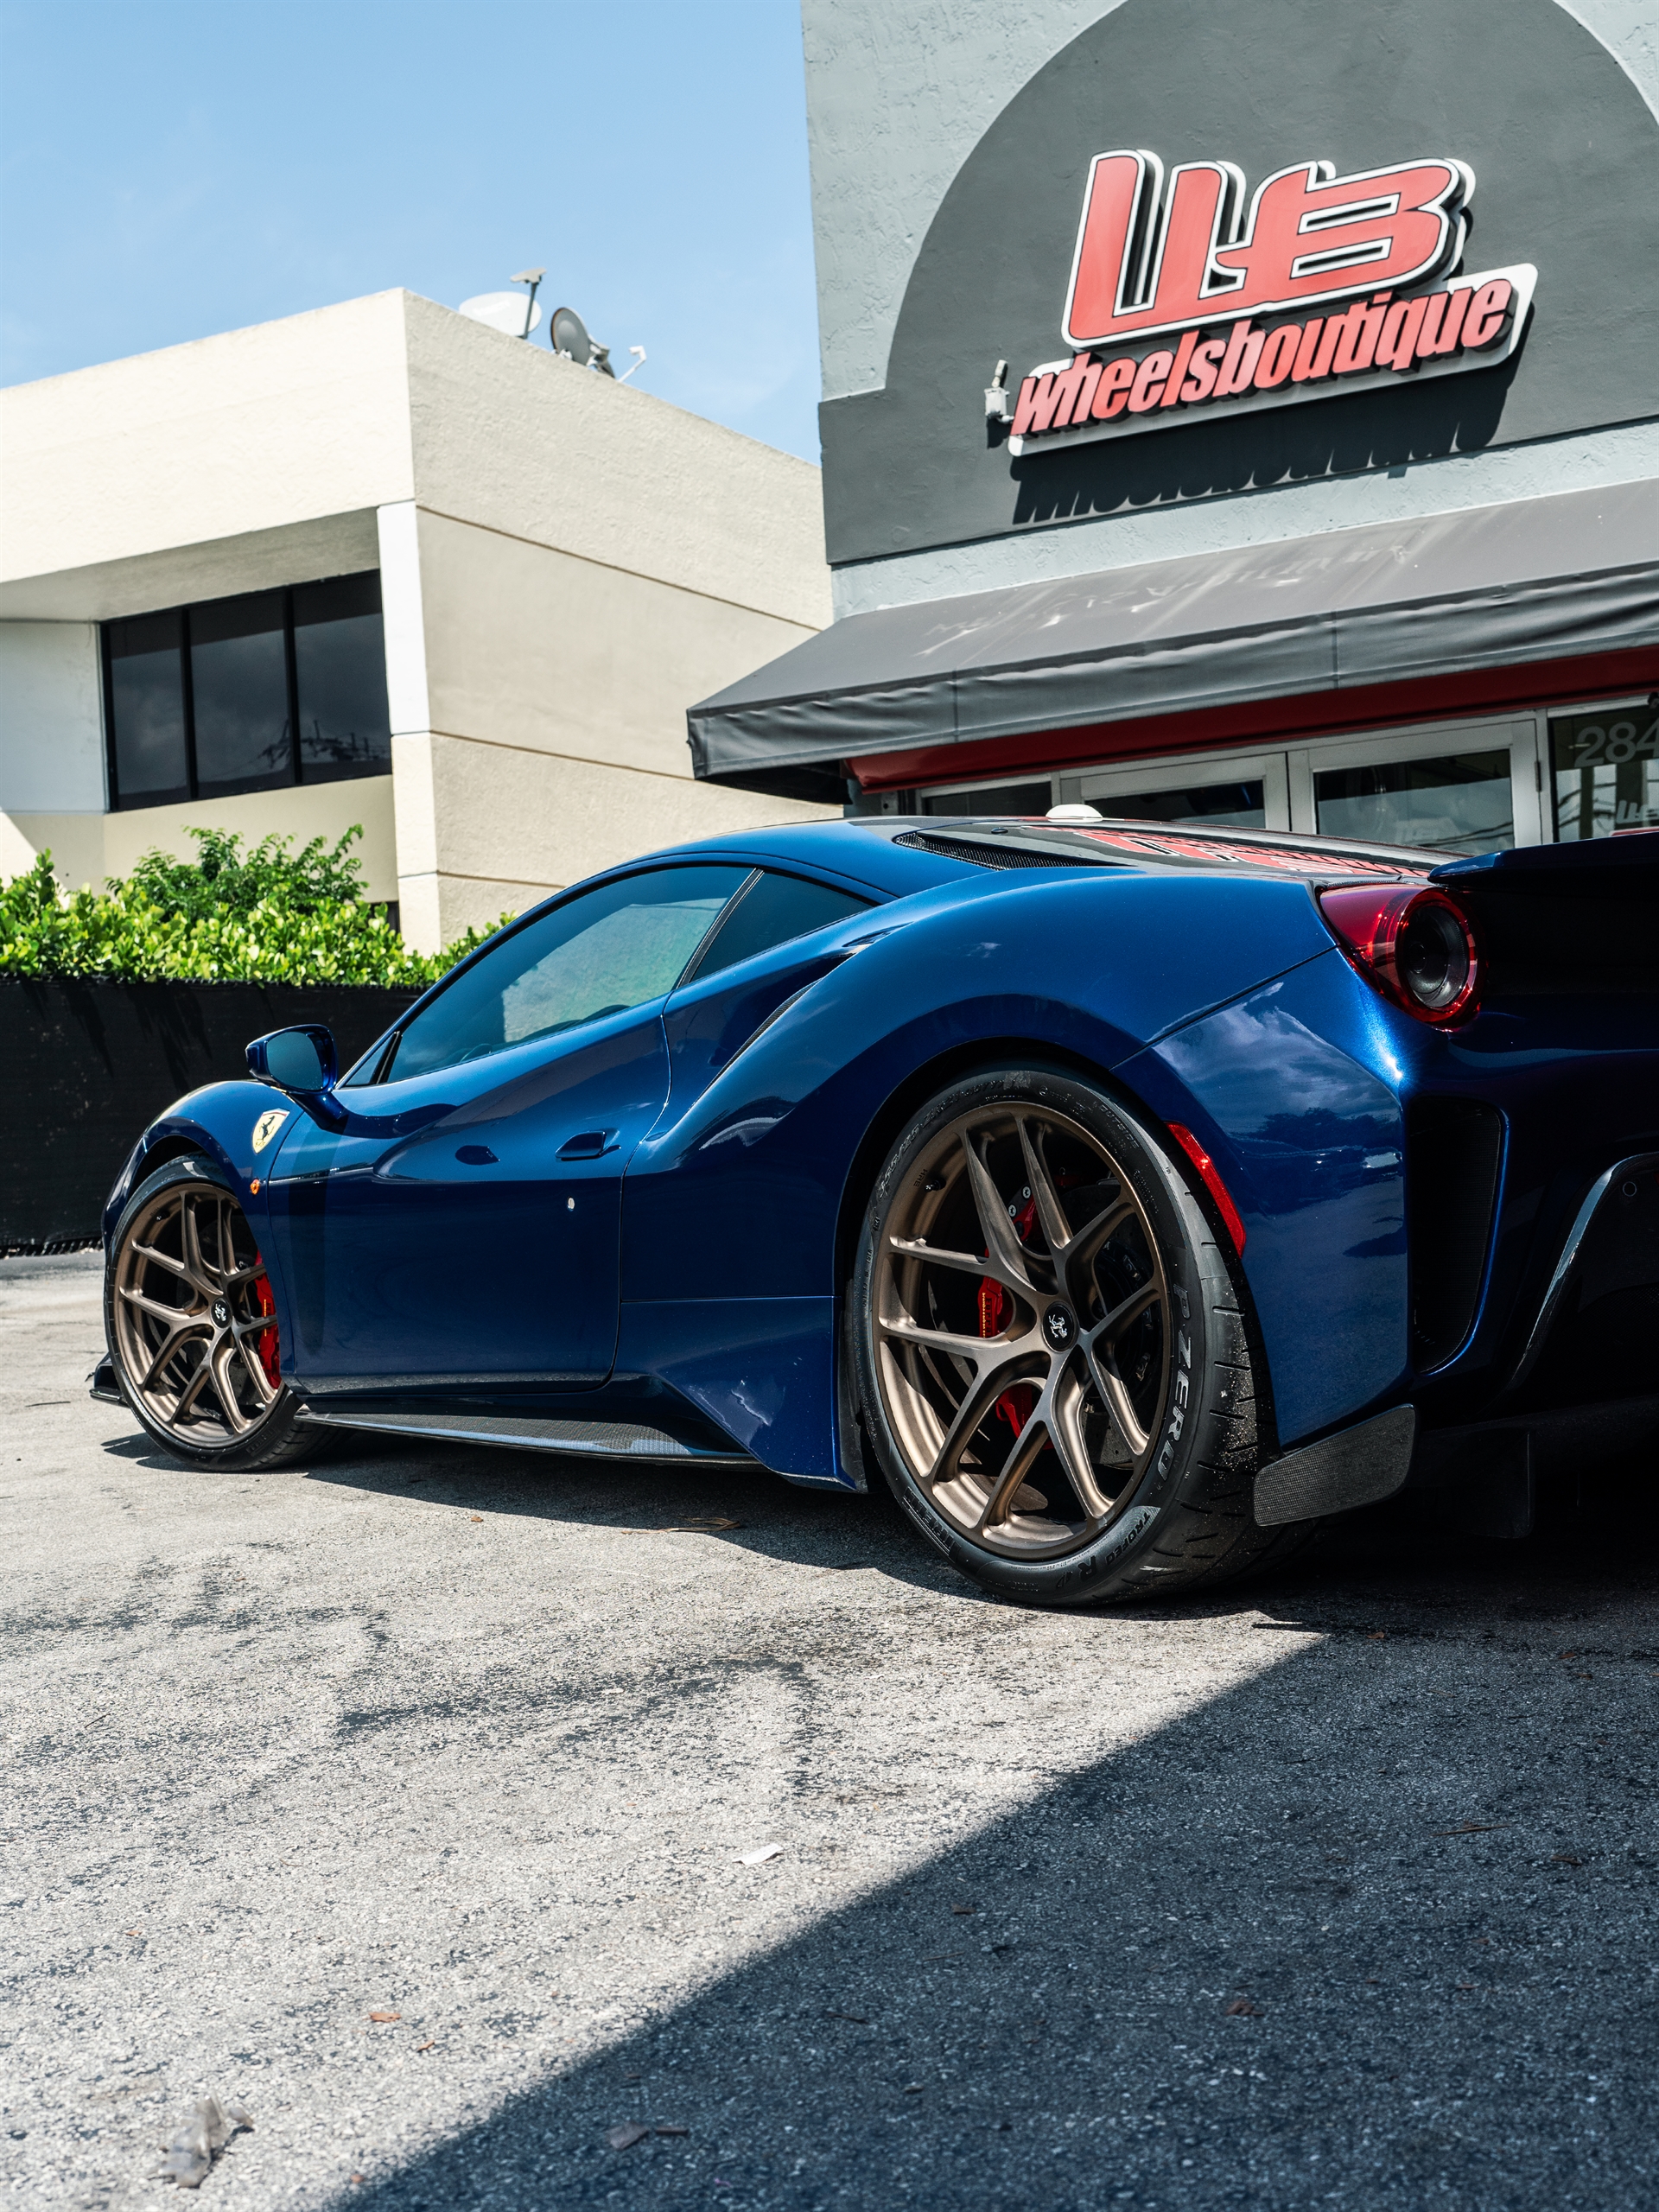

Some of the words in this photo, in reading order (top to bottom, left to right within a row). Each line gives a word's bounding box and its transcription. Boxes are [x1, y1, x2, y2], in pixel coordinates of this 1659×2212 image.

[1010, 276, 1514, 436] wheelsboutique
[912, 1168, 928, 1188] HRE
[1173, 1283, 1192, 1320] P
[1157, 1330, 1192, 1481] ZERO
[1105, 1511, 1150, 1566] TROFEO
[1077, 1554, 1098, 1579] R
